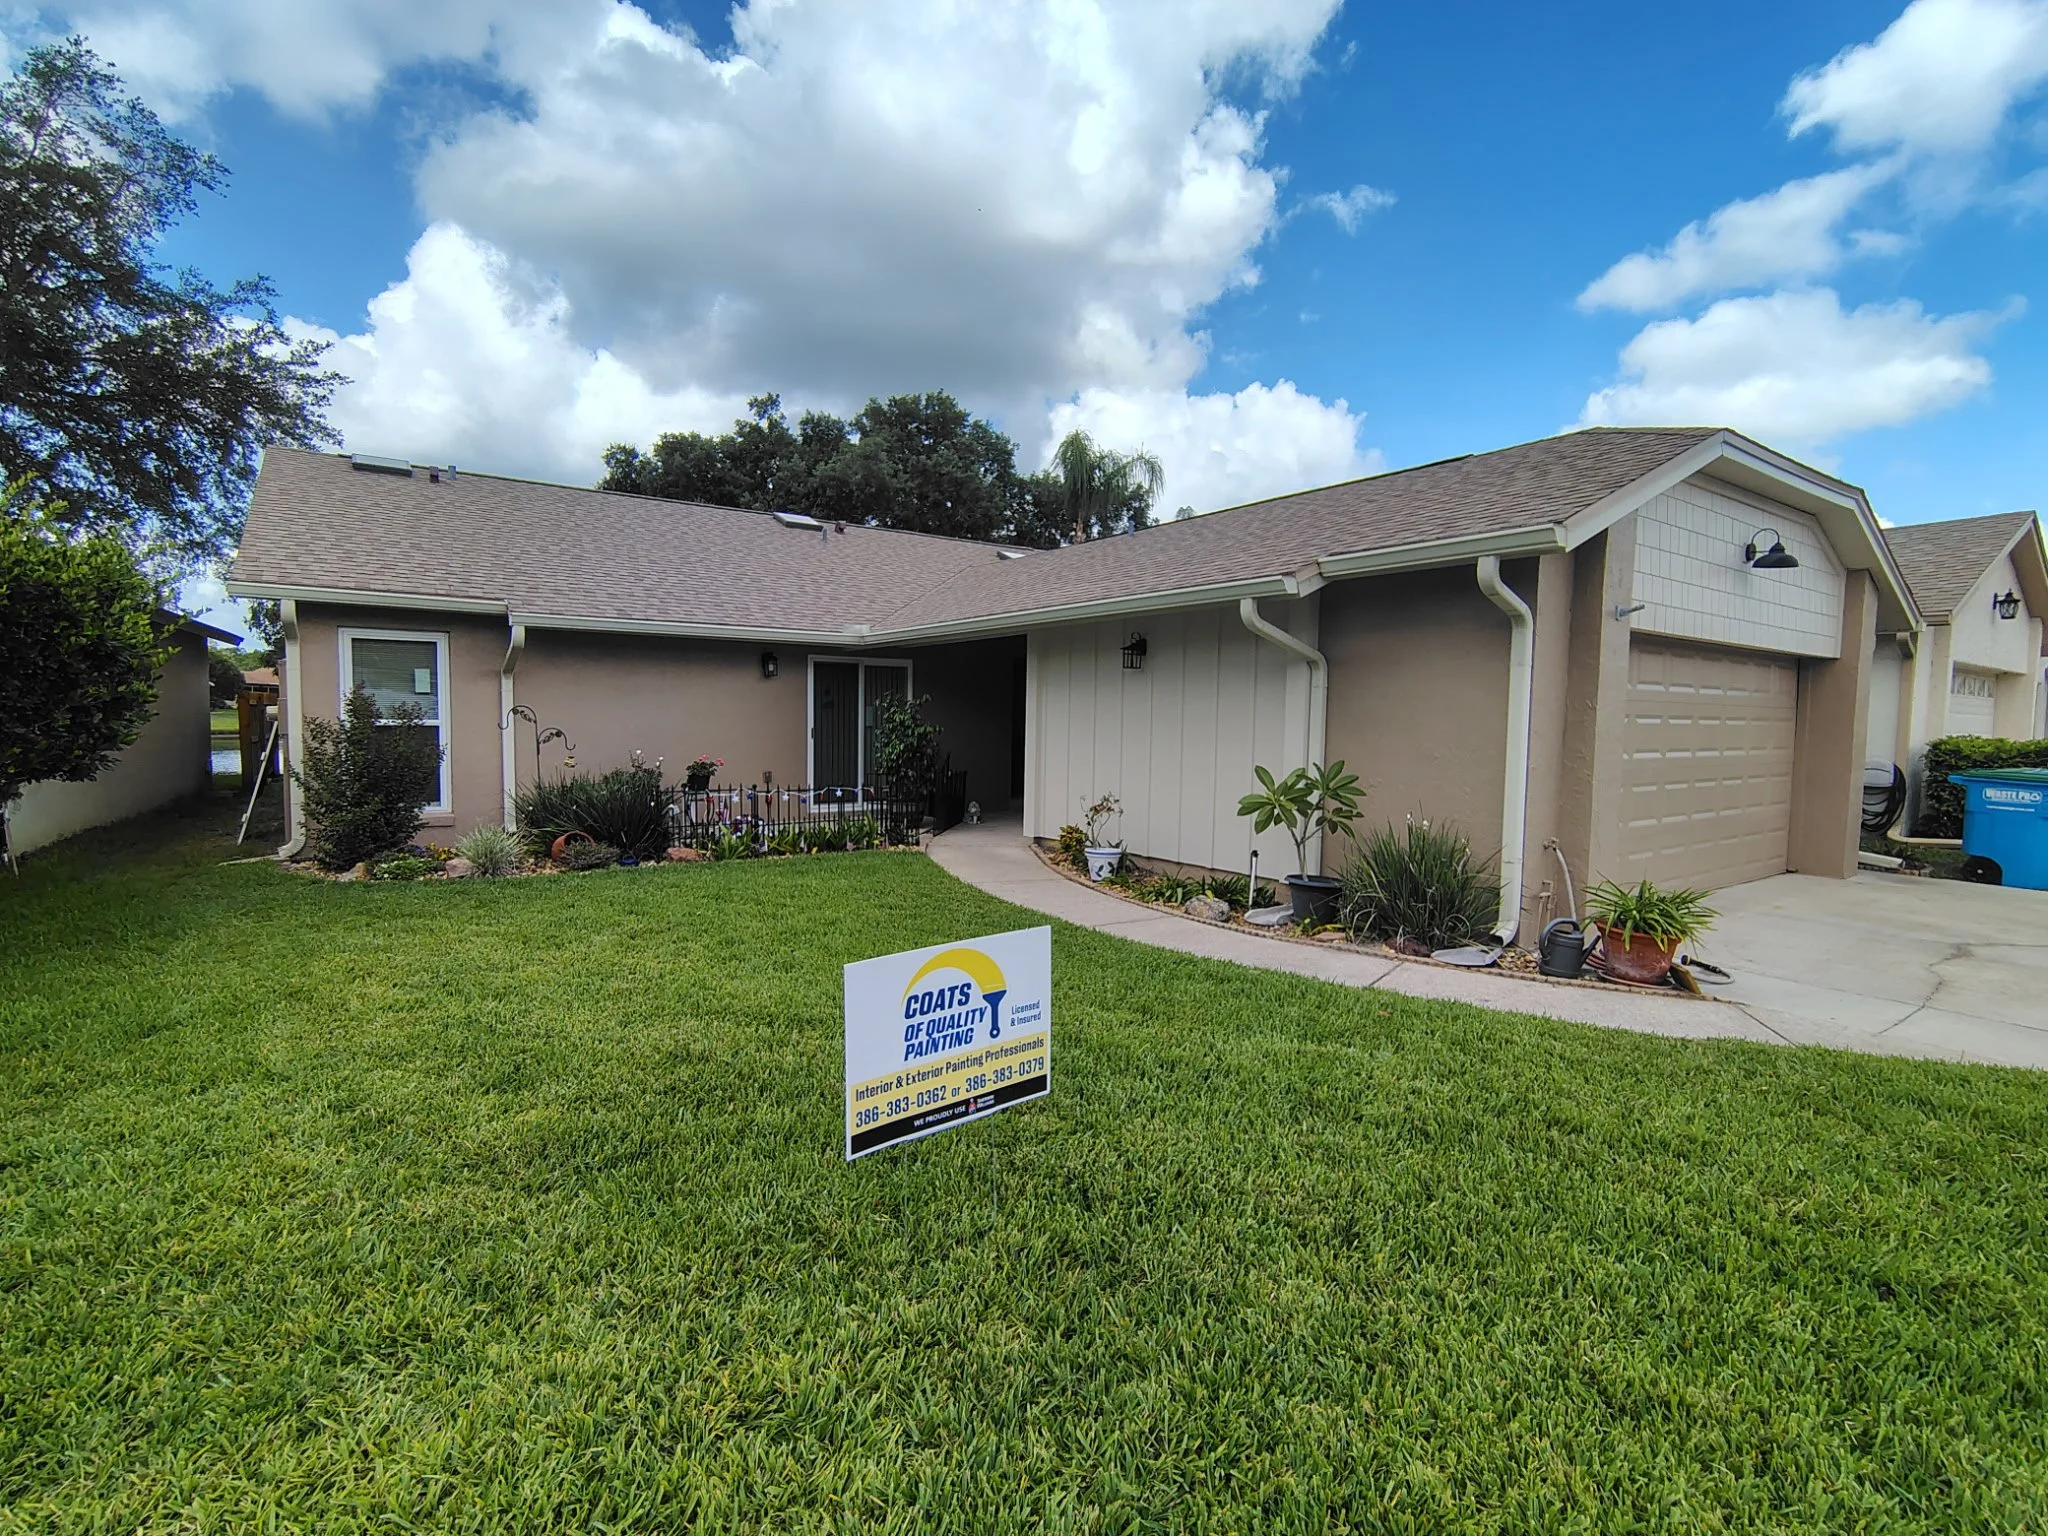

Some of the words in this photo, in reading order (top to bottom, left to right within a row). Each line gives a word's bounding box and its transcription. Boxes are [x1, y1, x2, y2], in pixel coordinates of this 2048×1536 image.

[904, 982, 972, 1020] COATS
[1010, 1017, 1016, 1027] &
[1016, 1011, 1042, 1025] Insured
[1011, 1000, 1041, 1015] Licensed
[904, 1021, 925, 1043] OF
[925, 1006, 988, 1039] QUALITY
[904, 1027, 975, 1062] PAINTING
[855, 1080, 894, 1102] Interior
[895, 1075, 904, 1089] &
[905, 1065, 944, 1087] Exterior
[945, 1055, 984, 1075] Painting
[985, 1037, 1045, 1063] Professionals
[855, 1085, 947, 1128] 386-383-0362
[951, 1086, 961, 1097] or
[965, 1056, 1045, 1093] 386-383-0379
[913, 1119, 924, 1128] WE
[925, 1109, 954, 1124] PROUDLY
[954, 1105, 967, 1114] USE
